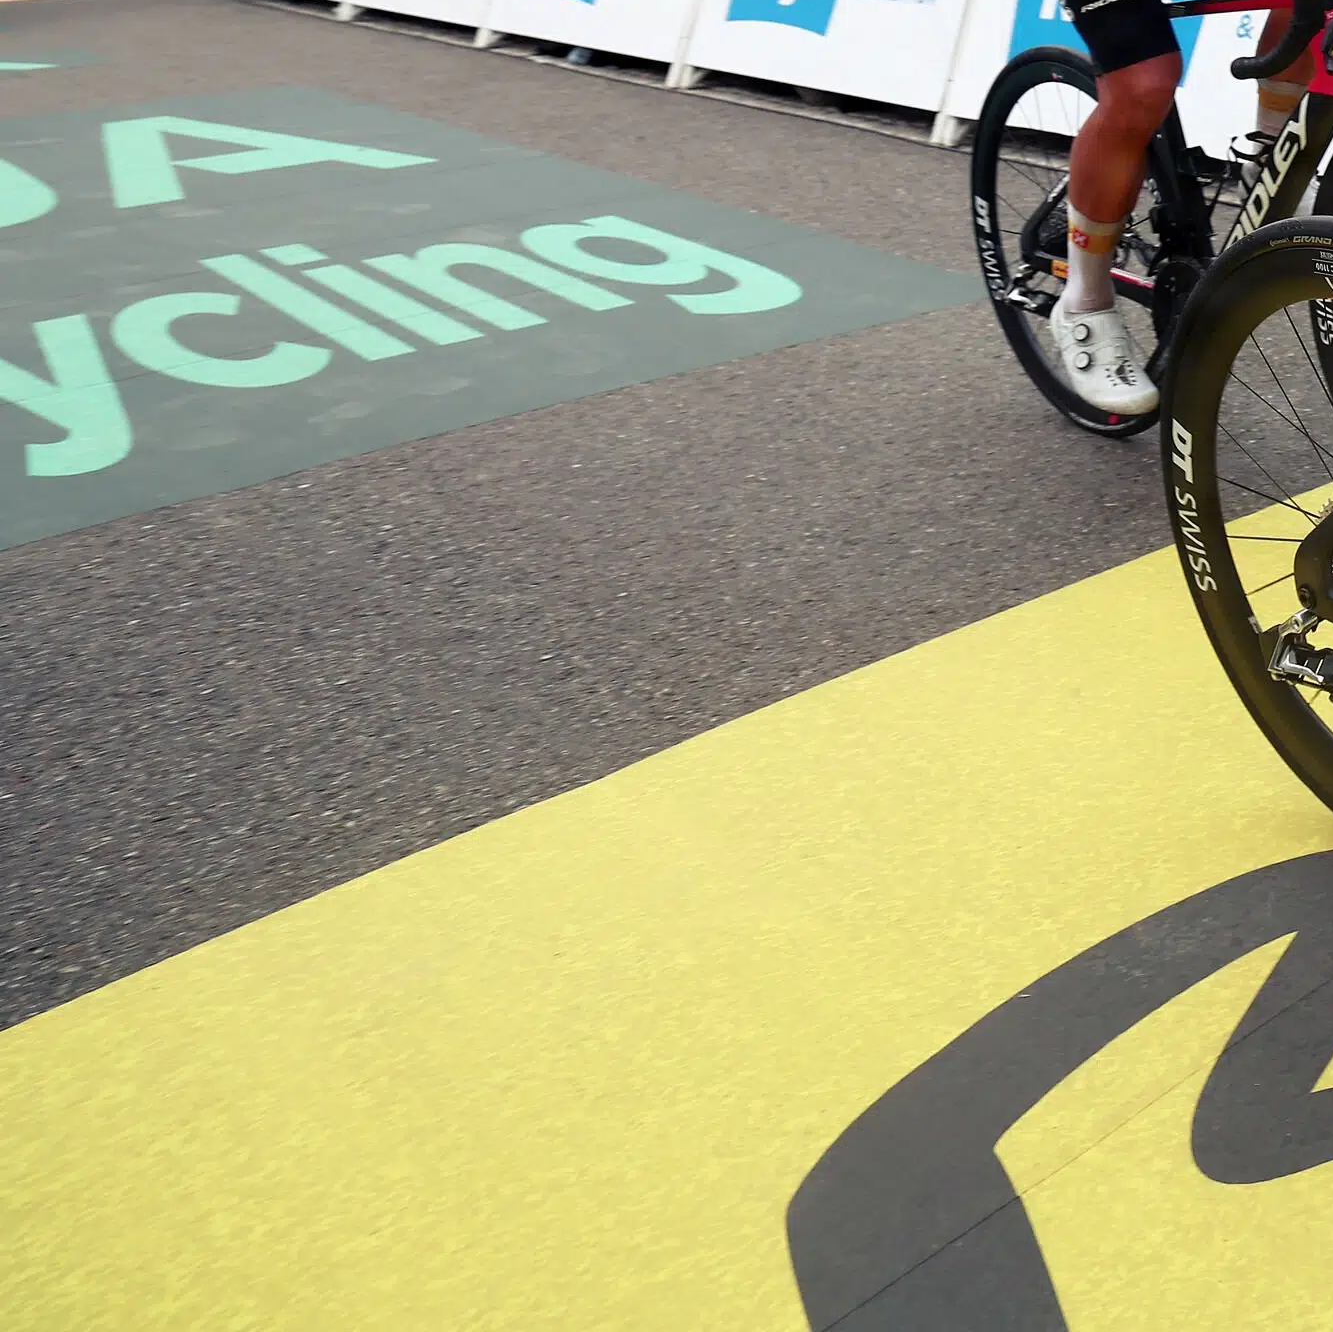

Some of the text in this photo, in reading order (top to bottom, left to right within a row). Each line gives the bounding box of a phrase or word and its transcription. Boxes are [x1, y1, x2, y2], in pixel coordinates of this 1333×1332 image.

[974, 195, 1005, 301] DT SWISS
[1292, 235, 1332, 246] GRAND
[1171, 418, 1218, 594] DT SWISS
